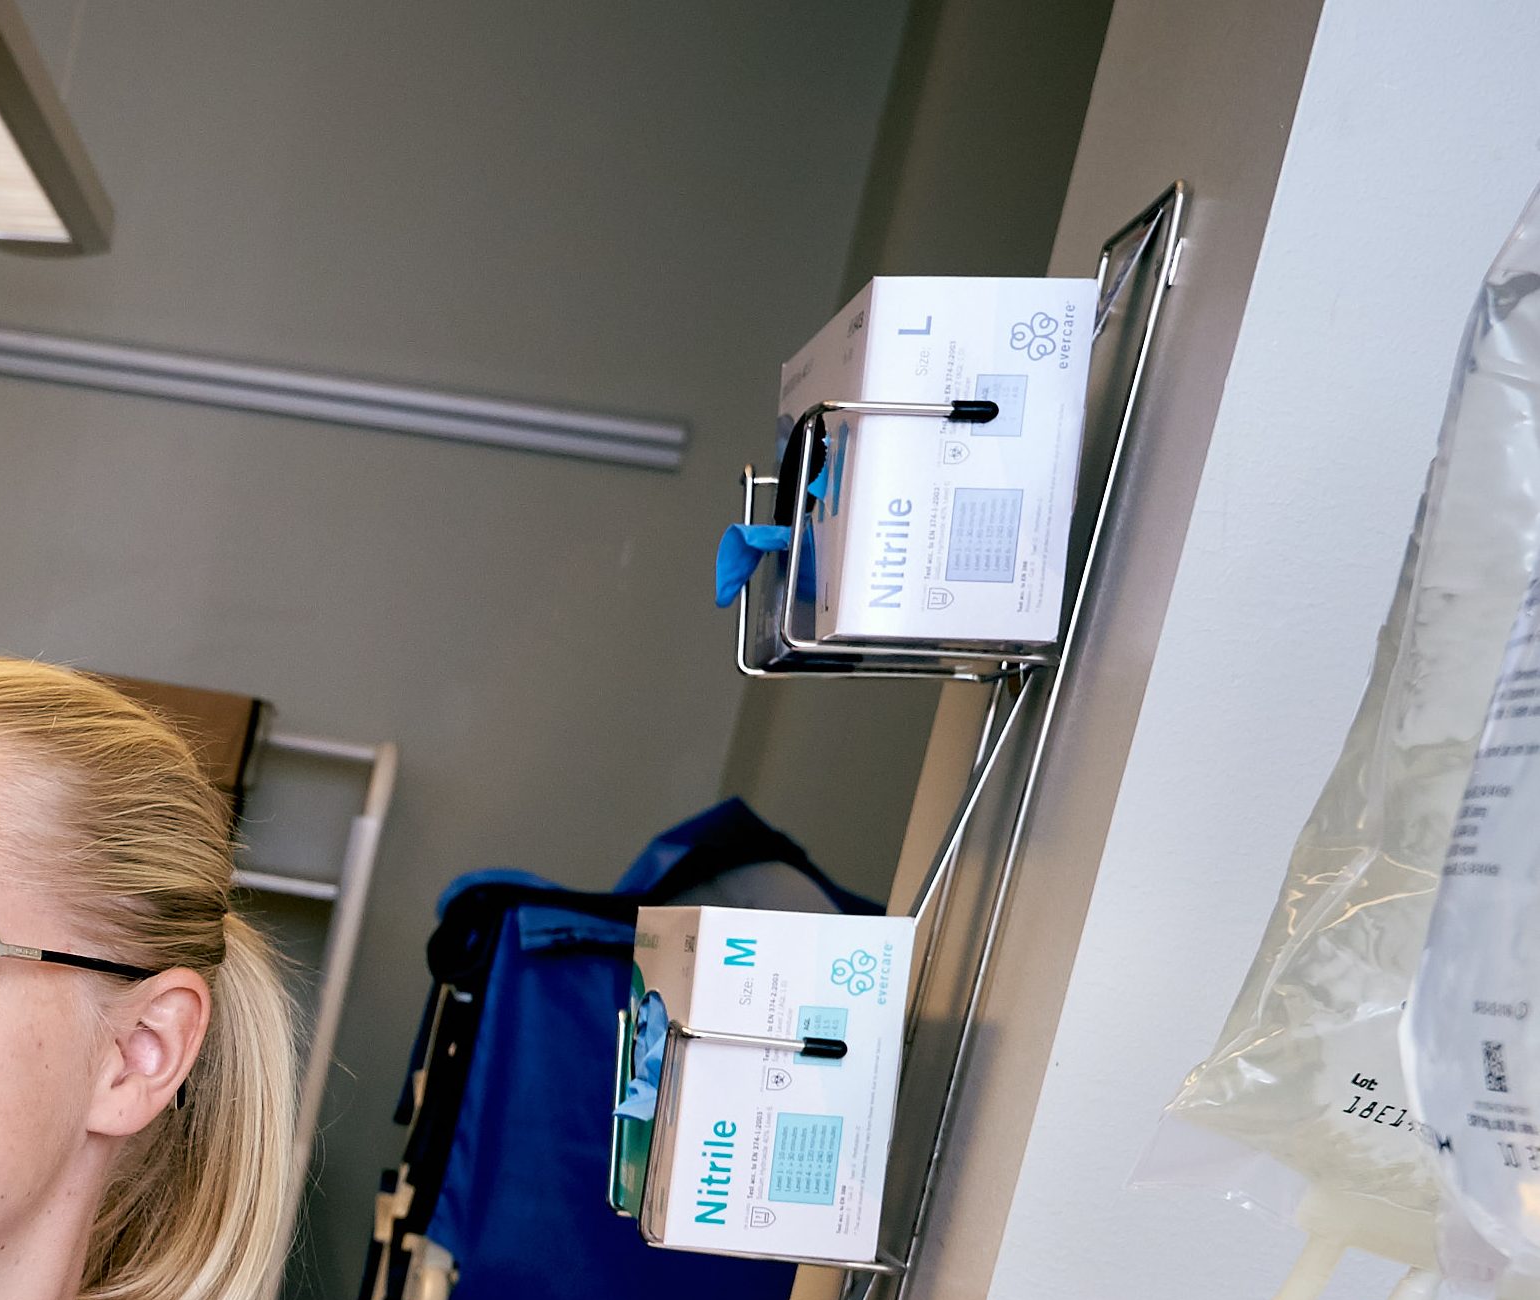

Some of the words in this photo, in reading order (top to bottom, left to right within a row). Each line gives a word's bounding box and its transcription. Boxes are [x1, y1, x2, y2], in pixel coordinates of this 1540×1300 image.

[898, 315, 933, 336] L
[1058, 302, 1076, 370] evercare
[915, 344, 932, 376] Size:
[944, 384, 952, 394] EN
[868, 497, 913, 610] Nitrile
[924, 566, 932, 580] Test
[928, 530, 936, 540] EN
[724, 938, 757, 968] M
[877, 943, 892, 1006] evercare
[739, 976, 754, 1007] Size:
[767, 1014, 775, 1024] EN
[1351, 1073, 1379, 1091] Lot
[694, 1119, 737, 1226] Nitrile
[747, 1185, 755, 1199] Test
[752, 1151, 758, 1161] EN
